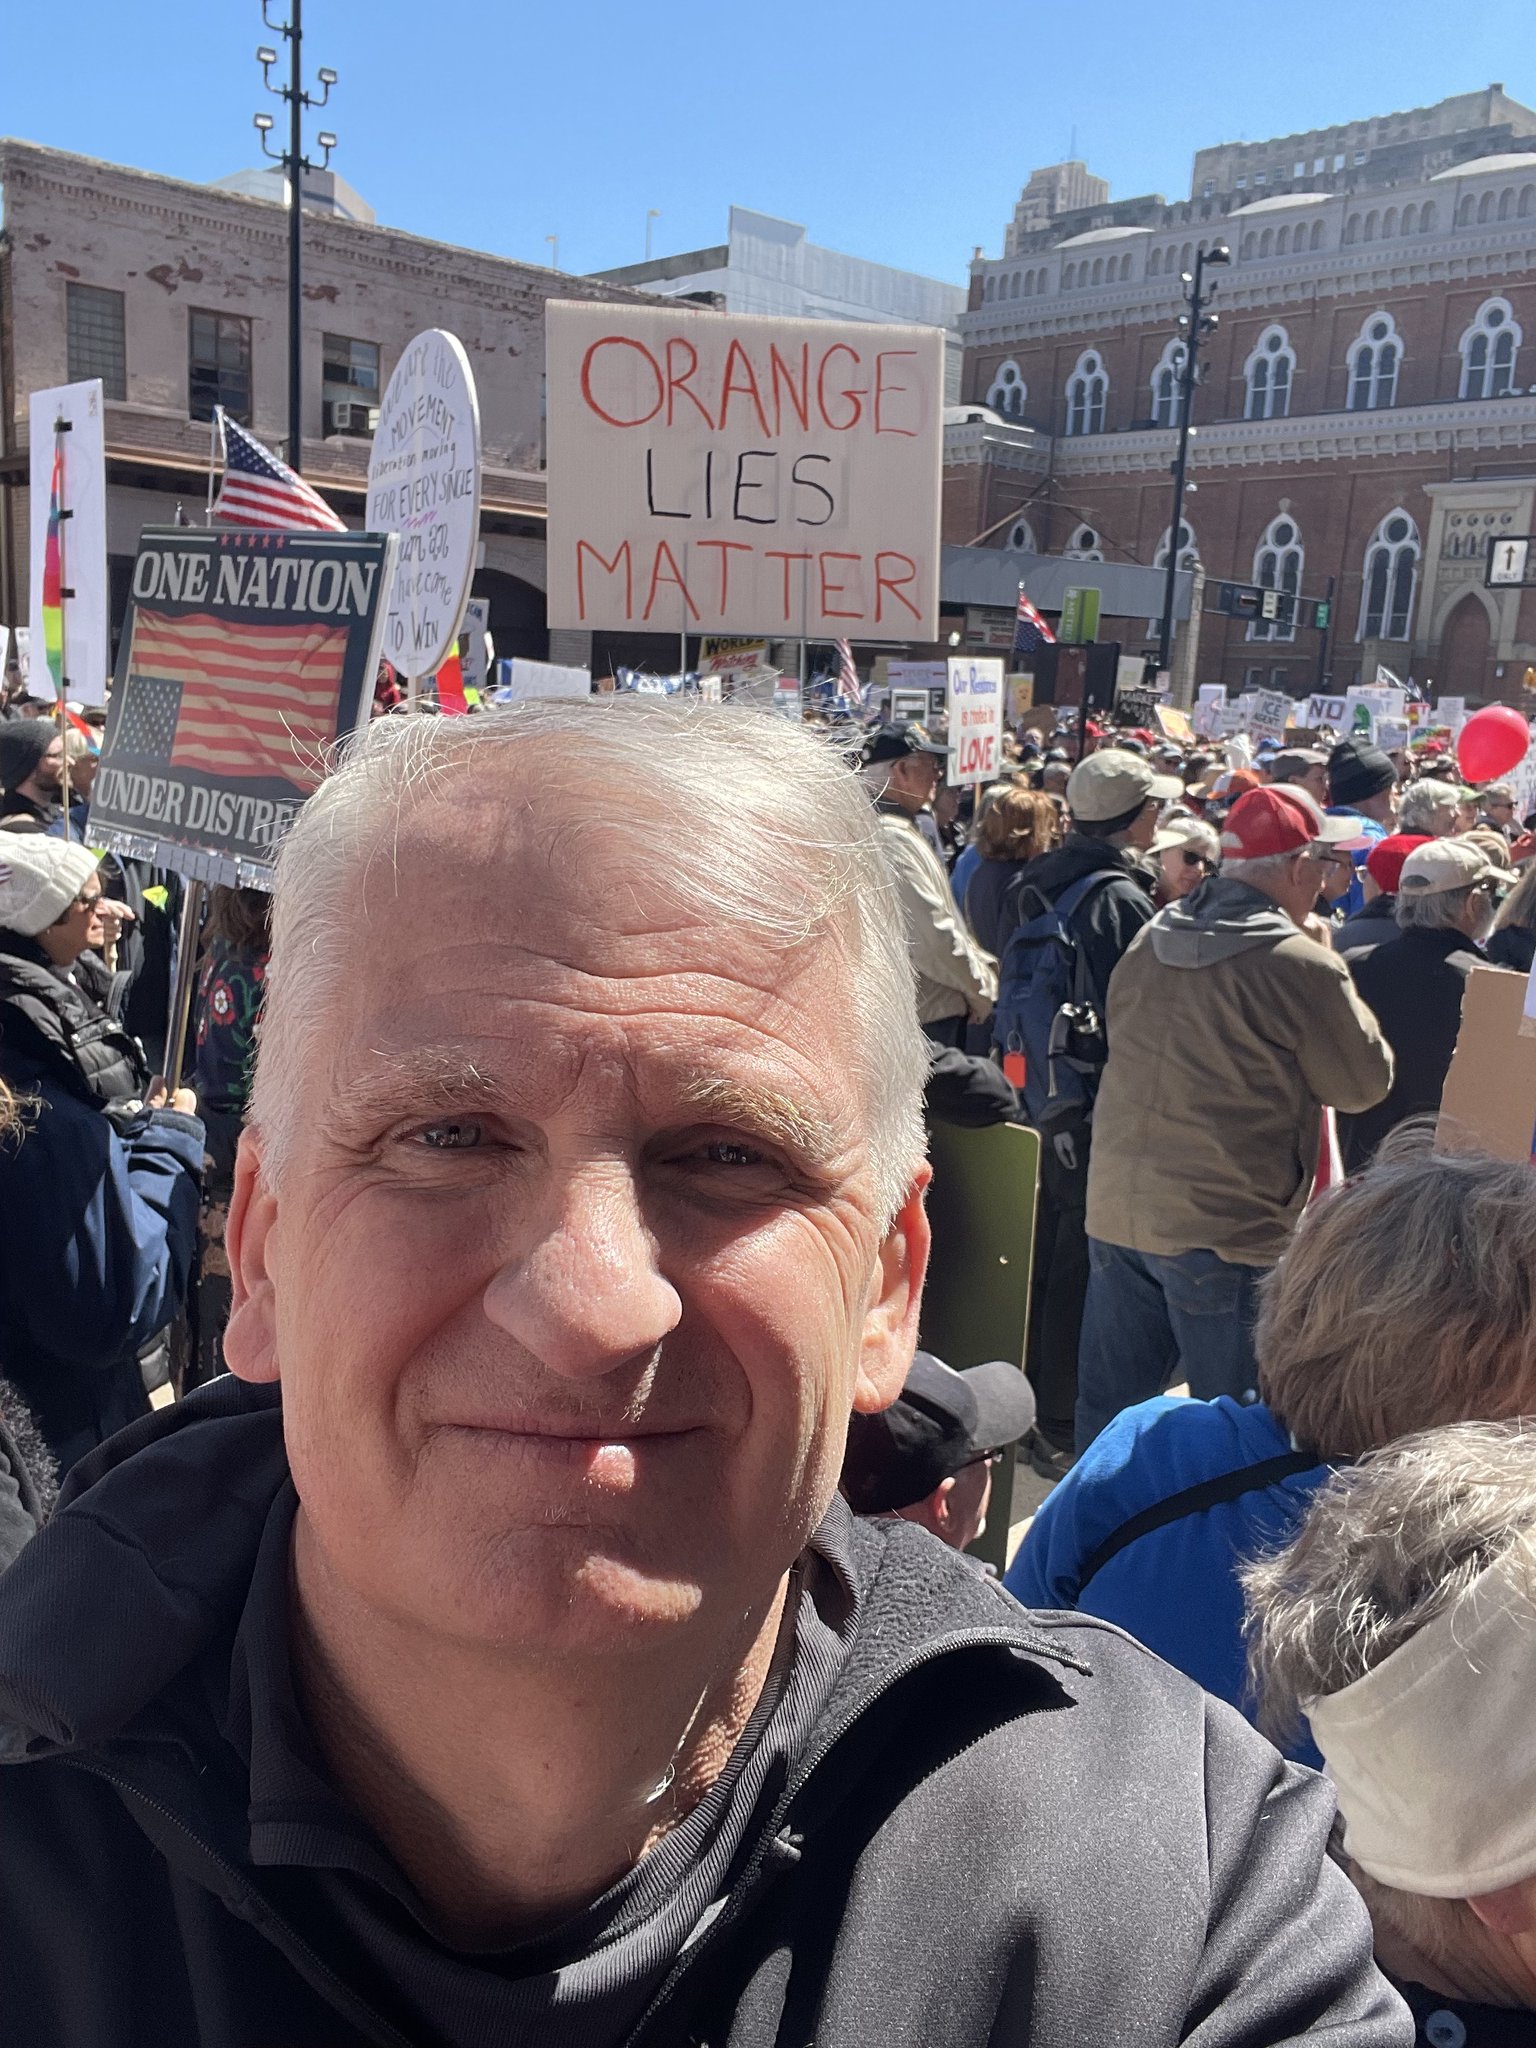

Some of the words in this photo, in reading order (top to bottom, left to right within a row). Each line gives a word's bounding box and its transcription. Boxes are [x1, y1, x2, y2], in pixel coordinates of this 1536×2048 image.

[580, 335, 918, 438] ORANGE
[389, 394, 455, 452] MOVEMENT
[421, 440, 456, 472] moving
[372, 489, 396, 523] FOR
[400, 471, 438, 518] EVERY
[647, 448, 835, 526] LIES
[133, 551, 211, 603] ONE
[212, 554, 378, 616] NATION
[577, 540, 921, 622] MATTER
[389, 612, 404, 650] TO
[411, 606, 439, 651] WIN
[1261, 700, 1282, 717] ICE
[959, 736, 994, 774] LOVE
[96, 767, 185, 826] UNDER
[185, 785, 299, 845] DISTRE
